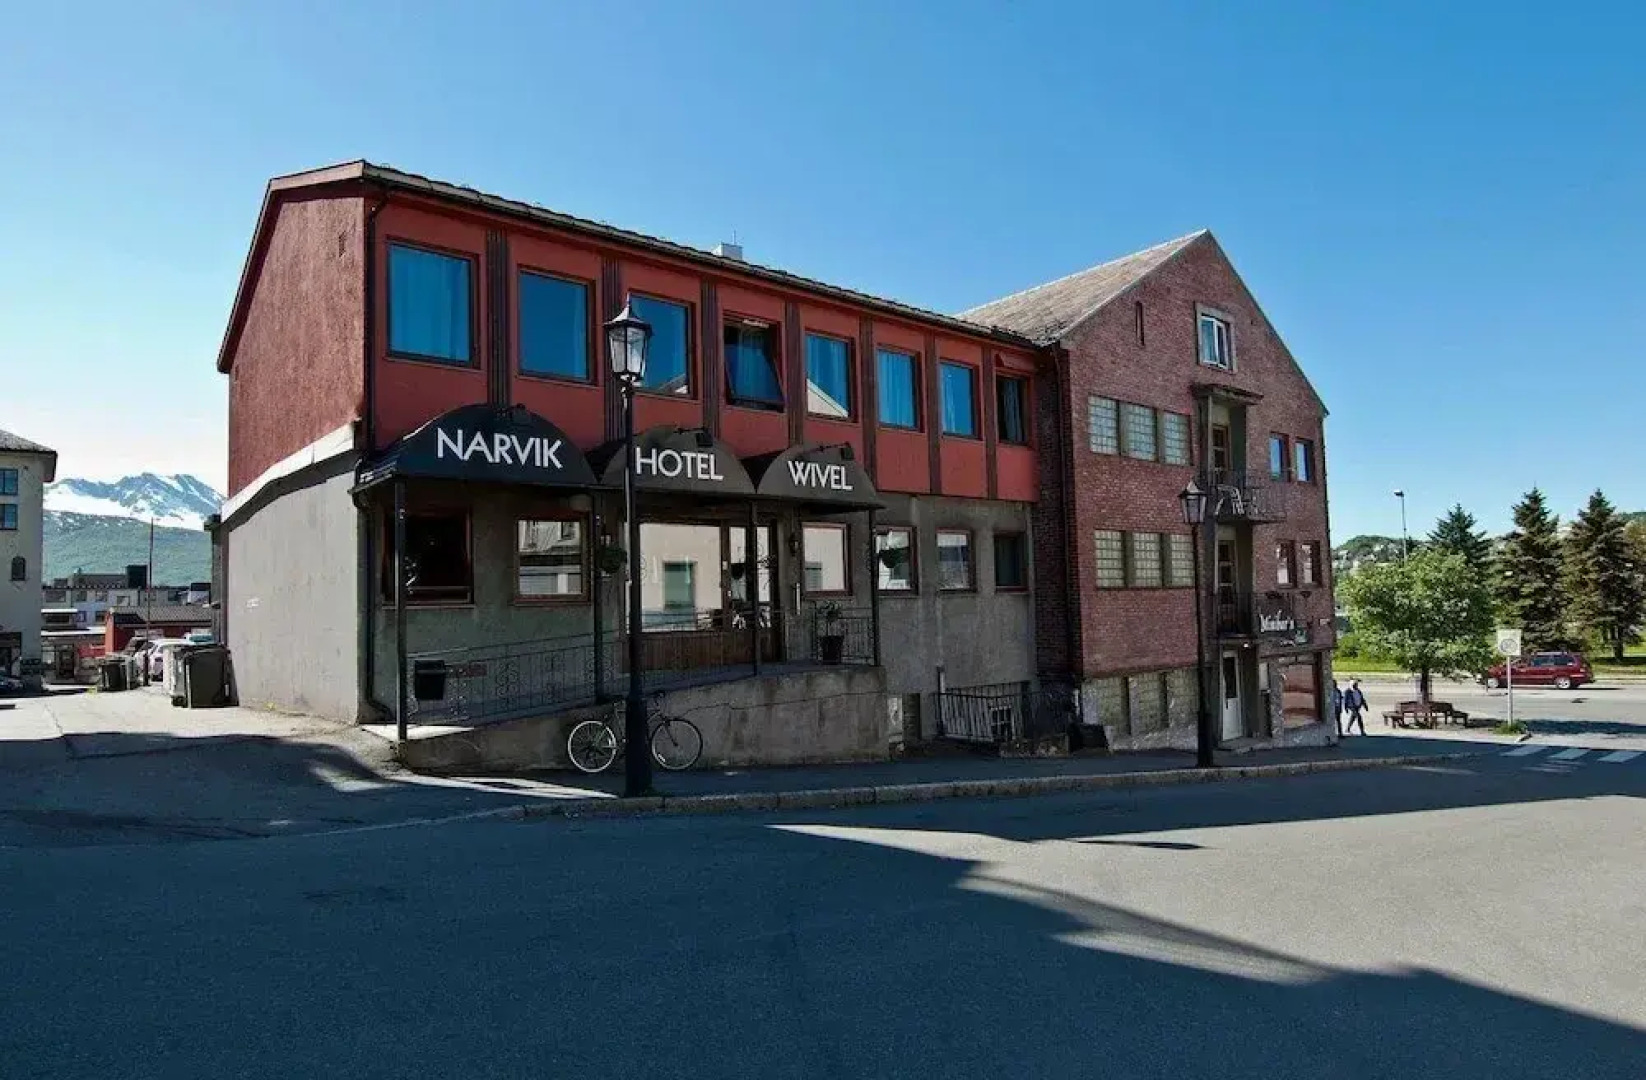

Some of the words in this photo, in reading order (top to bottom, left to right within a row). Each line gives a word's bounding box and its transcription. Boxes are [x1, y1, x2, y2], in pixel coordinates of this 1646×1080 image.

[437, 427, 563, 469] NARVIK
[635, 447, 724, 480] HOTEL
[788, 460, 853, 490] WIVEL
